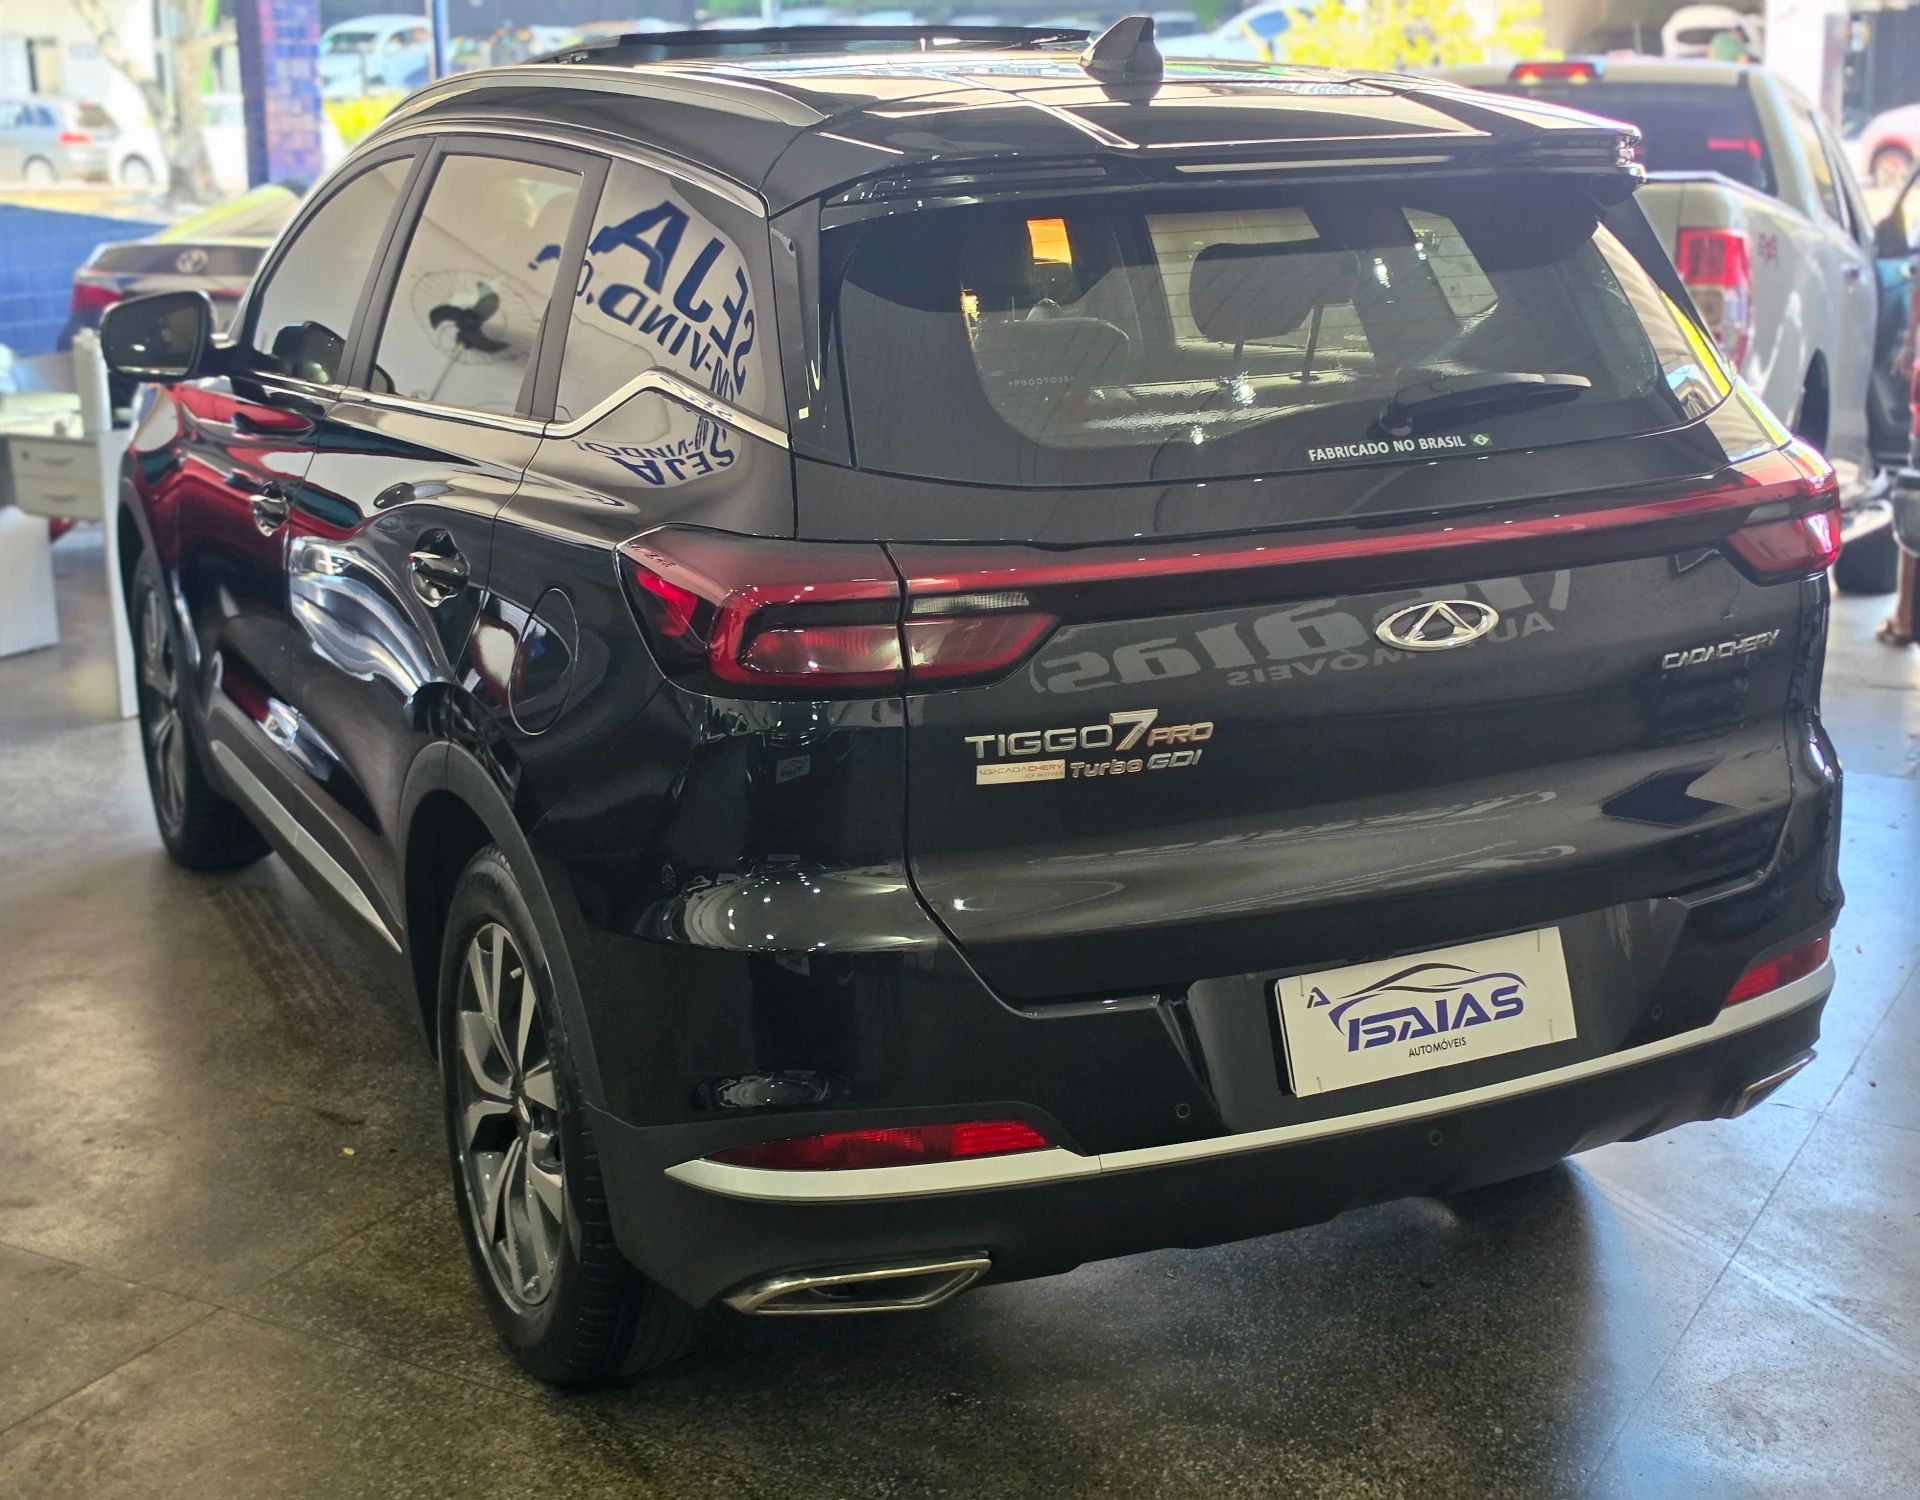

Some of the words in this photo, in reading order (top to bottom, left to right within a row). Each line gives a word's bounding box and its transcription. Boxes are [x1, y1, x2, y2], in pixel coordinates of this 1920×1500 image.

[1308, 440, 1389, 462] FABRICADO
[1393, 438, 1415, 452] NO
[1419, 435, 1467, 450] BRASIL
[964, 724, 1113, 759] TIGGO
[1108, 708, 1159, 751] 7
[1146, 721, 1214, 747] PRO
[1070, 758, 1143, 779] Turbo
[1147, 749, 1203, 770] GDI
[1347, 985, 1525, 1053] ISAIAS
[1408, 1036, 1467, 1058] AUTOMÓVEIS
